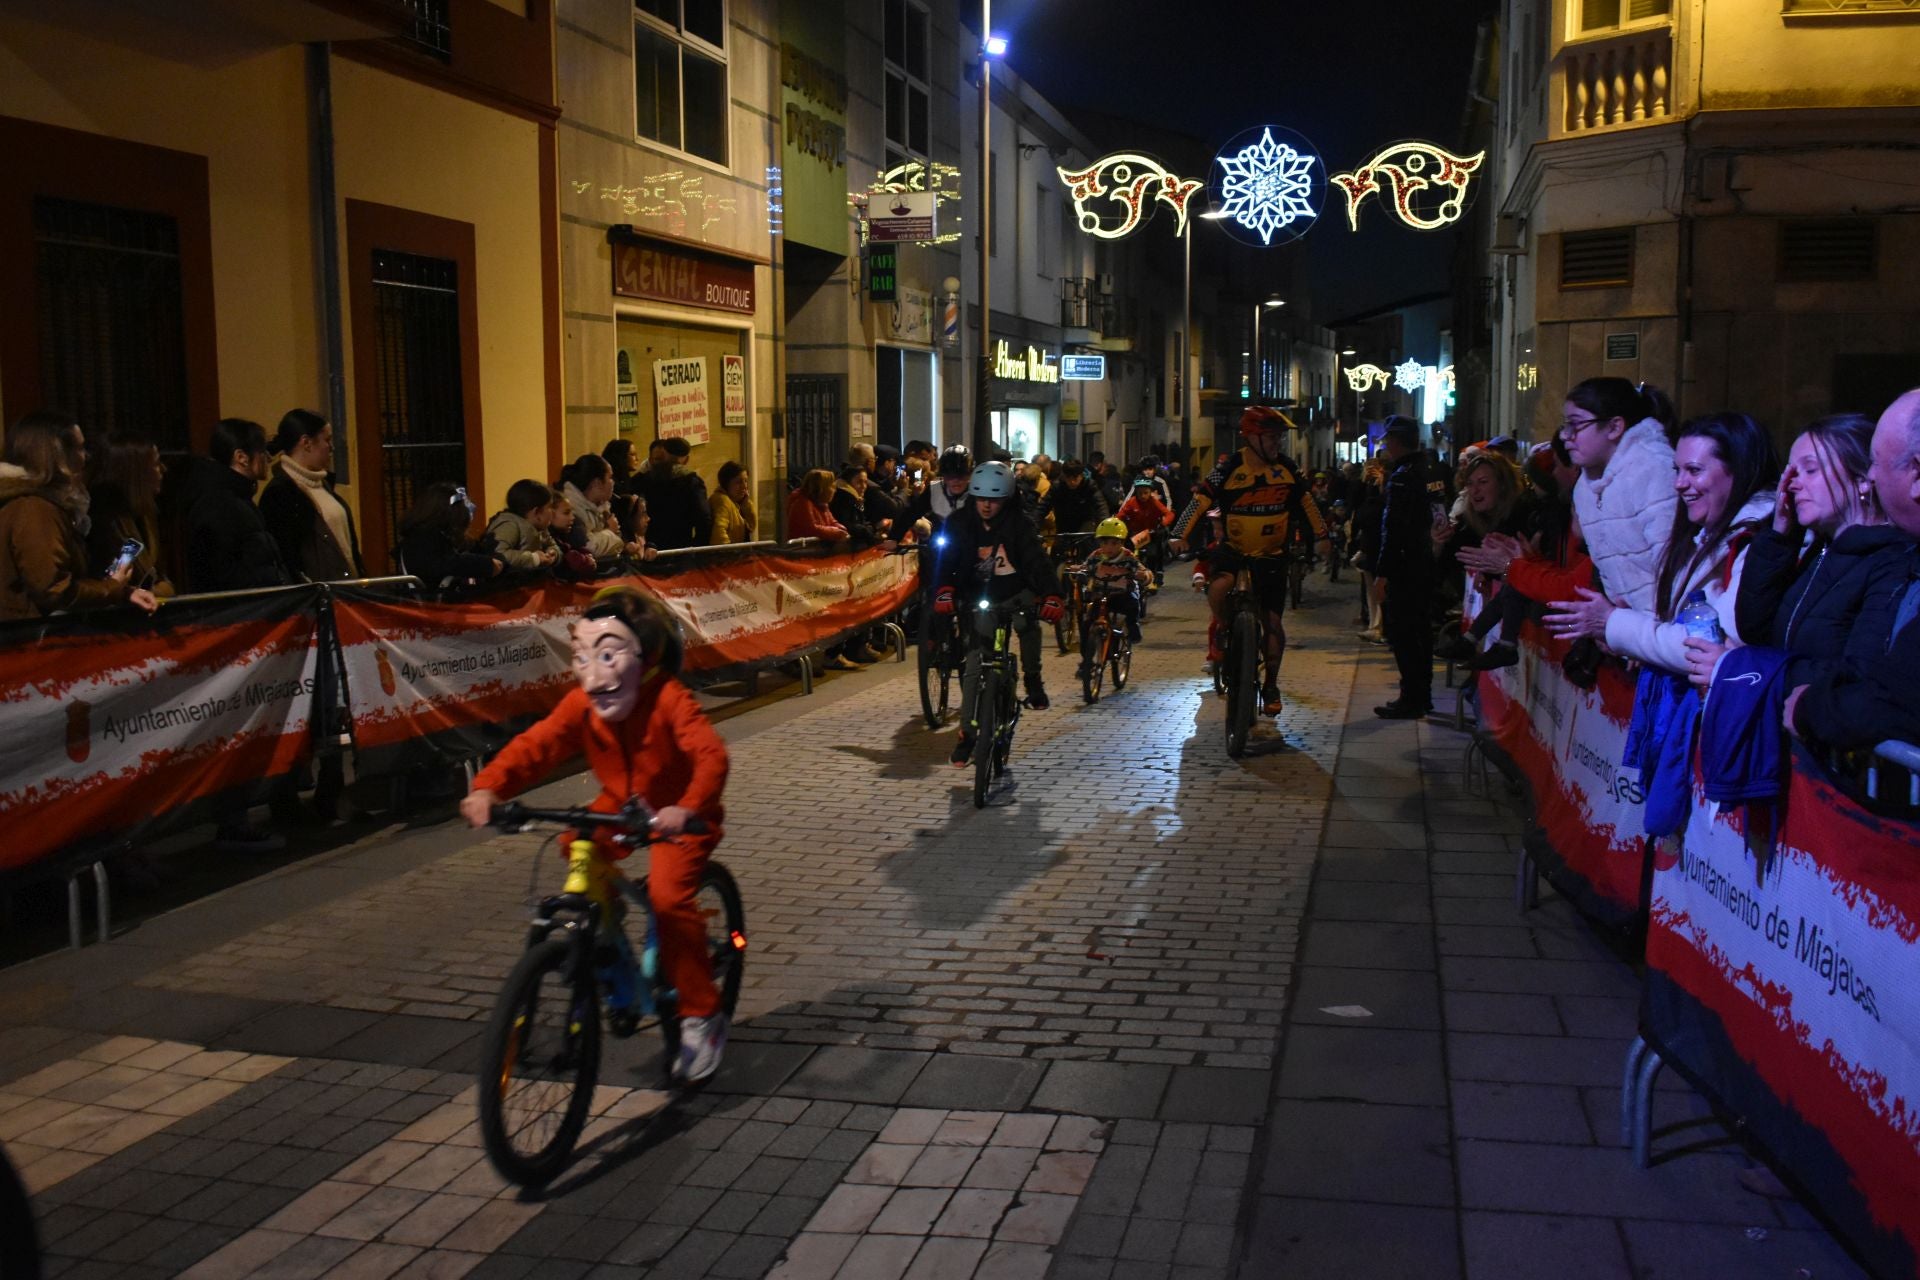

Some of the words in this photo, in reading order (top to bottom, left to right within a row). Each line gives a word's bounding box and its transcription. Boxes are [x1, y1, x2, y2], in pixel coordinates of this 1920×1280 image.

[621, 246, 701, 301] GENIAL
[872, 275, 894, 291] BAR
[705, 283, 751, 308] BOUTIQUE
[661, 362, 701, 386] CERRADO
[480, 650, 495, 668] de
[497, 642, 547, 667] Miajadas
[103, 696, 225, 743] Ayuntamiento
[1685, 848, 1760, 931] yuntamiento
[1765, 905, 1790, 949] de
